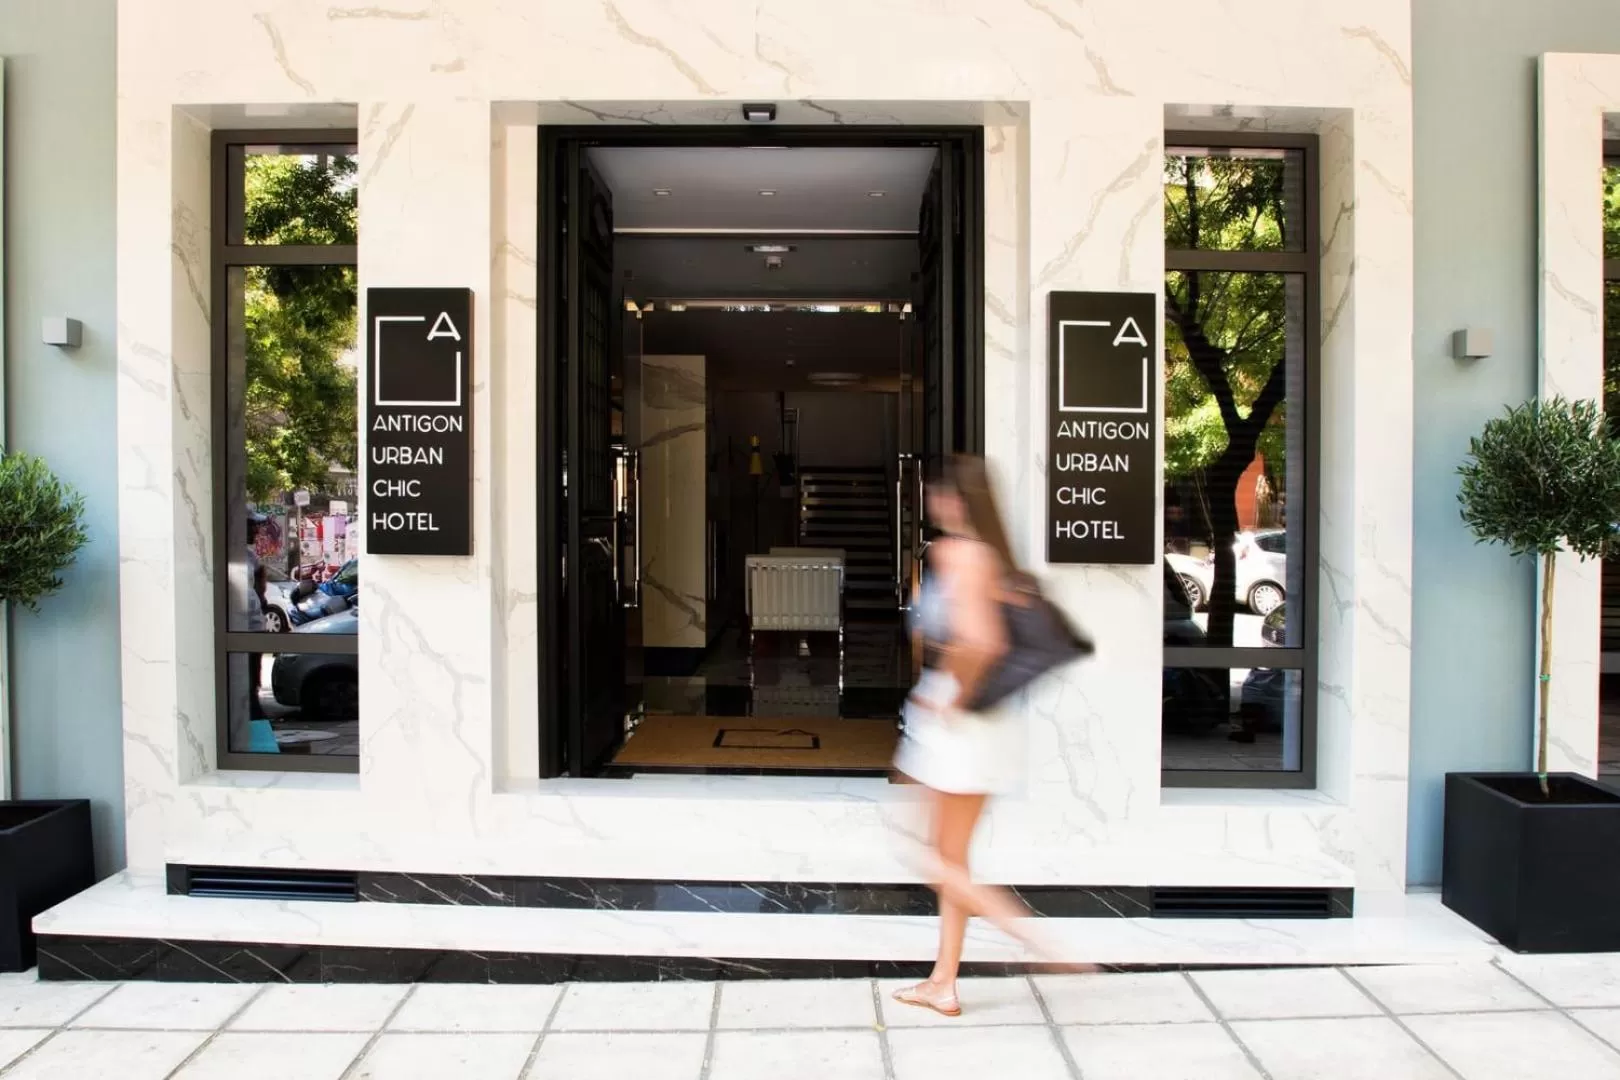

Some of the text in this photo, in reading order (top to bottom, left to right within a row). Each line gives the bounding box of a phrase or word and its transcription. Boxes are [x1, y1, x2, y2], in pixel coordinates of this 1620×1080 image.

[426, 311, 462, 342] A
[1112, 316, 1148, 348] A
[372, 414, 463, 433] ANTIGON
[1056, 420, 1149, 440] ANTIGON
[372, 446, 443, 465] URBAN
[1055, 452, 1129, 473] URBAN
[372, 479, 421, 498] CHIC
[1056, 486, 1106, 506] CHIC
[372, 512, 440, 531] HOTEL
[1055, 520, 1125, 540] HOTEL
